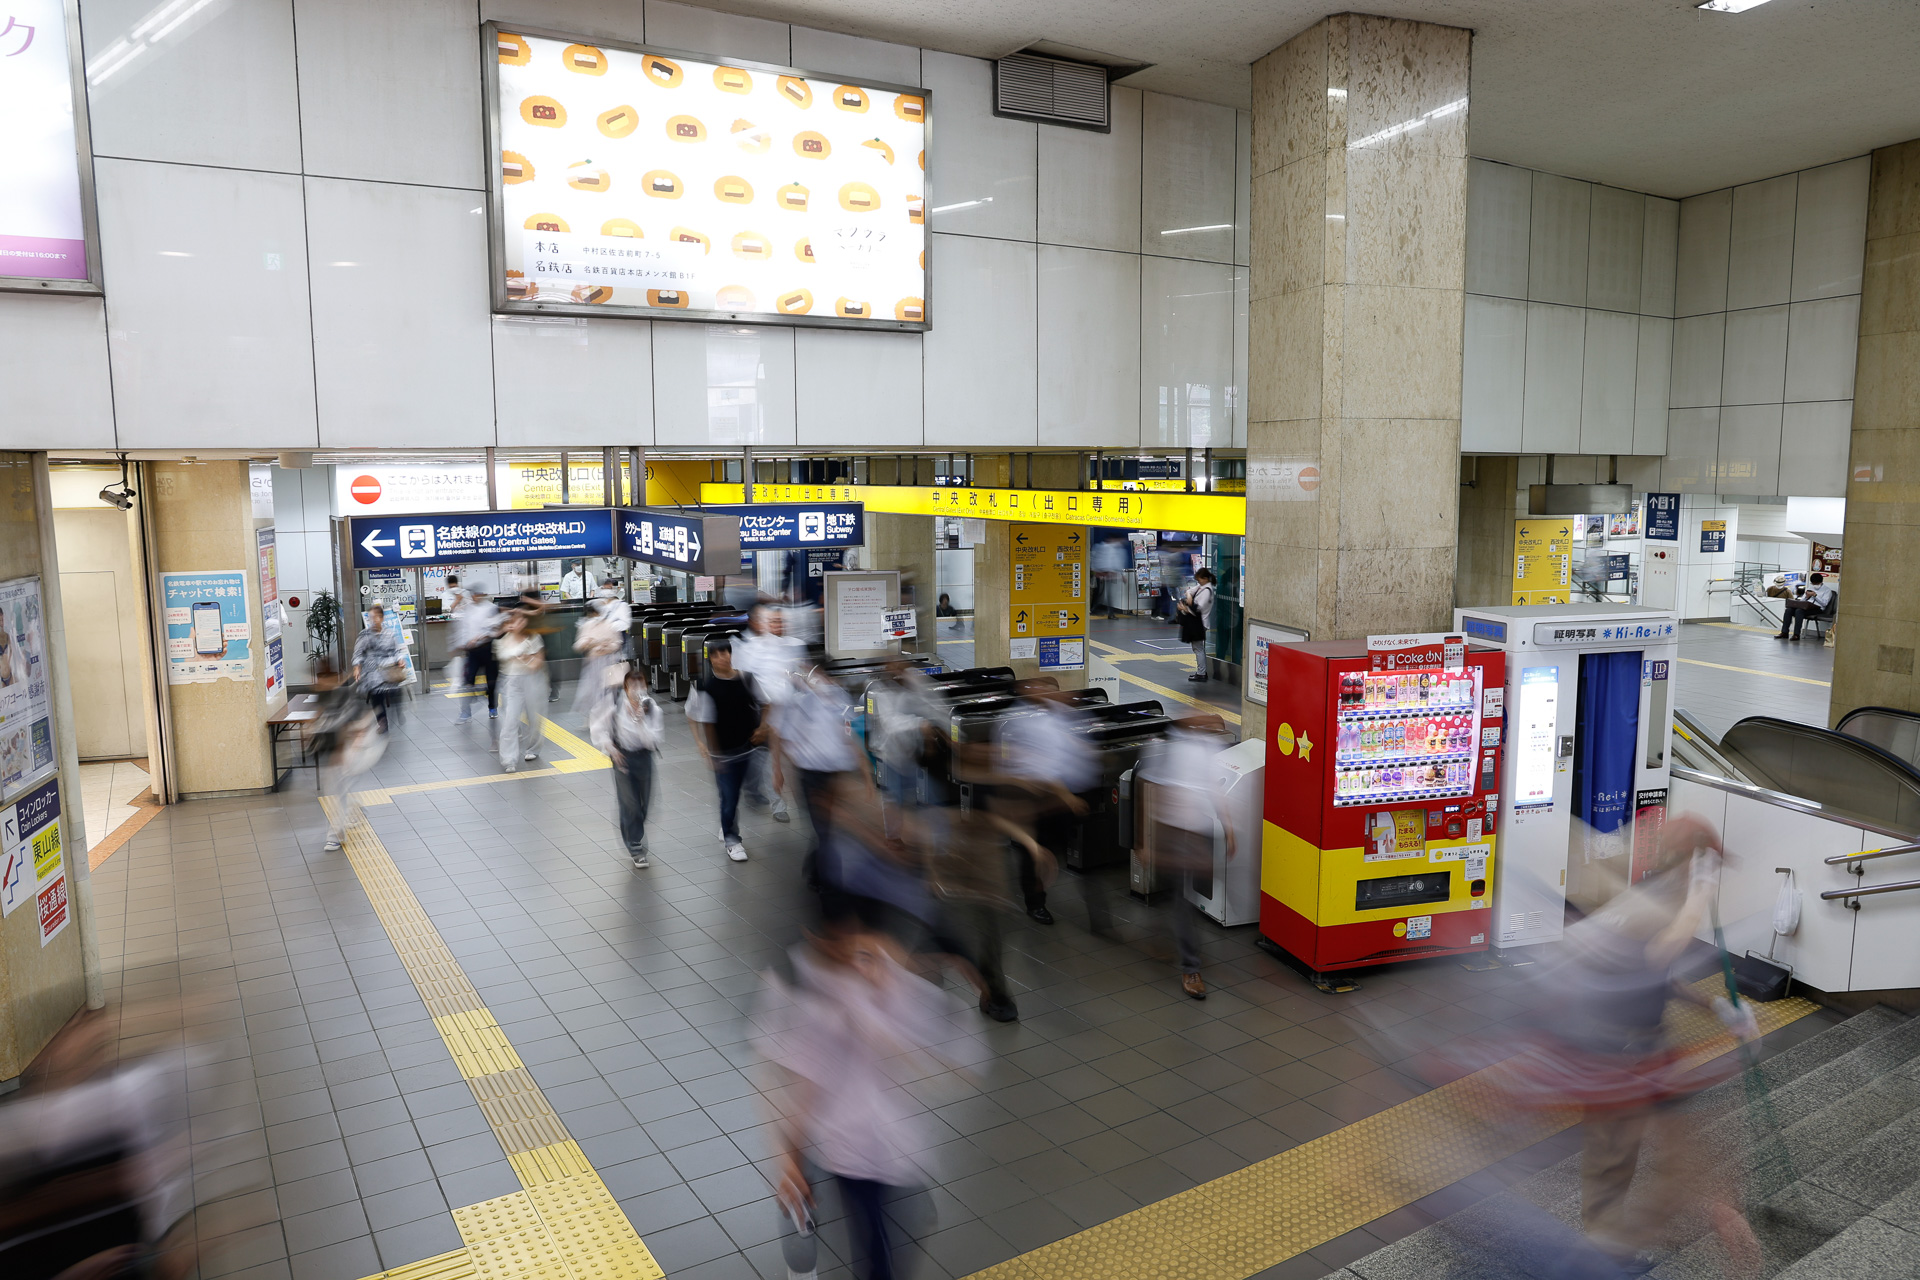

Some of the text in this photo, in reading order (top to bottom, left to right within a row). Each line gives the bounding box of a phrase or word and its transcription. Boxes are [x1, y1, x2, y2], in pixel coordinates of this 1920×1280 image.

[535, 241, 559, 254] 本店
[535, 260, 573, 274] 名鉄店
[387, 475, 489, 487] ここからは入れませ
[932, 490, 1143, 514] 中央改札口(出口専用)
[826, 513, 856, 526] 地下鉄
[436, 521, 586, 540] 名鉄線のりば(中央改札口)
[751, 529, 767, 537] Bus
[767, 528, 792, 537] Center
[826, 525, 854, 535] Subway
[437, 535, 557, 549] Meitetsu Line (Central Gates)
[167, 586, 242, 599] チャットで検索!
[1466, 620, 1504, 639] 証明写真
[1553, 628, 1597, 639] 証明写真
[1615, 624, 1663, 639] Ki-Re-i
[1396, 650, 1443, 665] Coke ON
[1654, 663, 1667, 674] ID
[19, 791, 57, 821] コインロッカー
[21, 811, 48, 834] Coin Lockers
[1398, 827, 1416, 835] たまる!
[33, 826, 61, 865] 東山線
[1398, 840, 1421, 849] もらえる!
